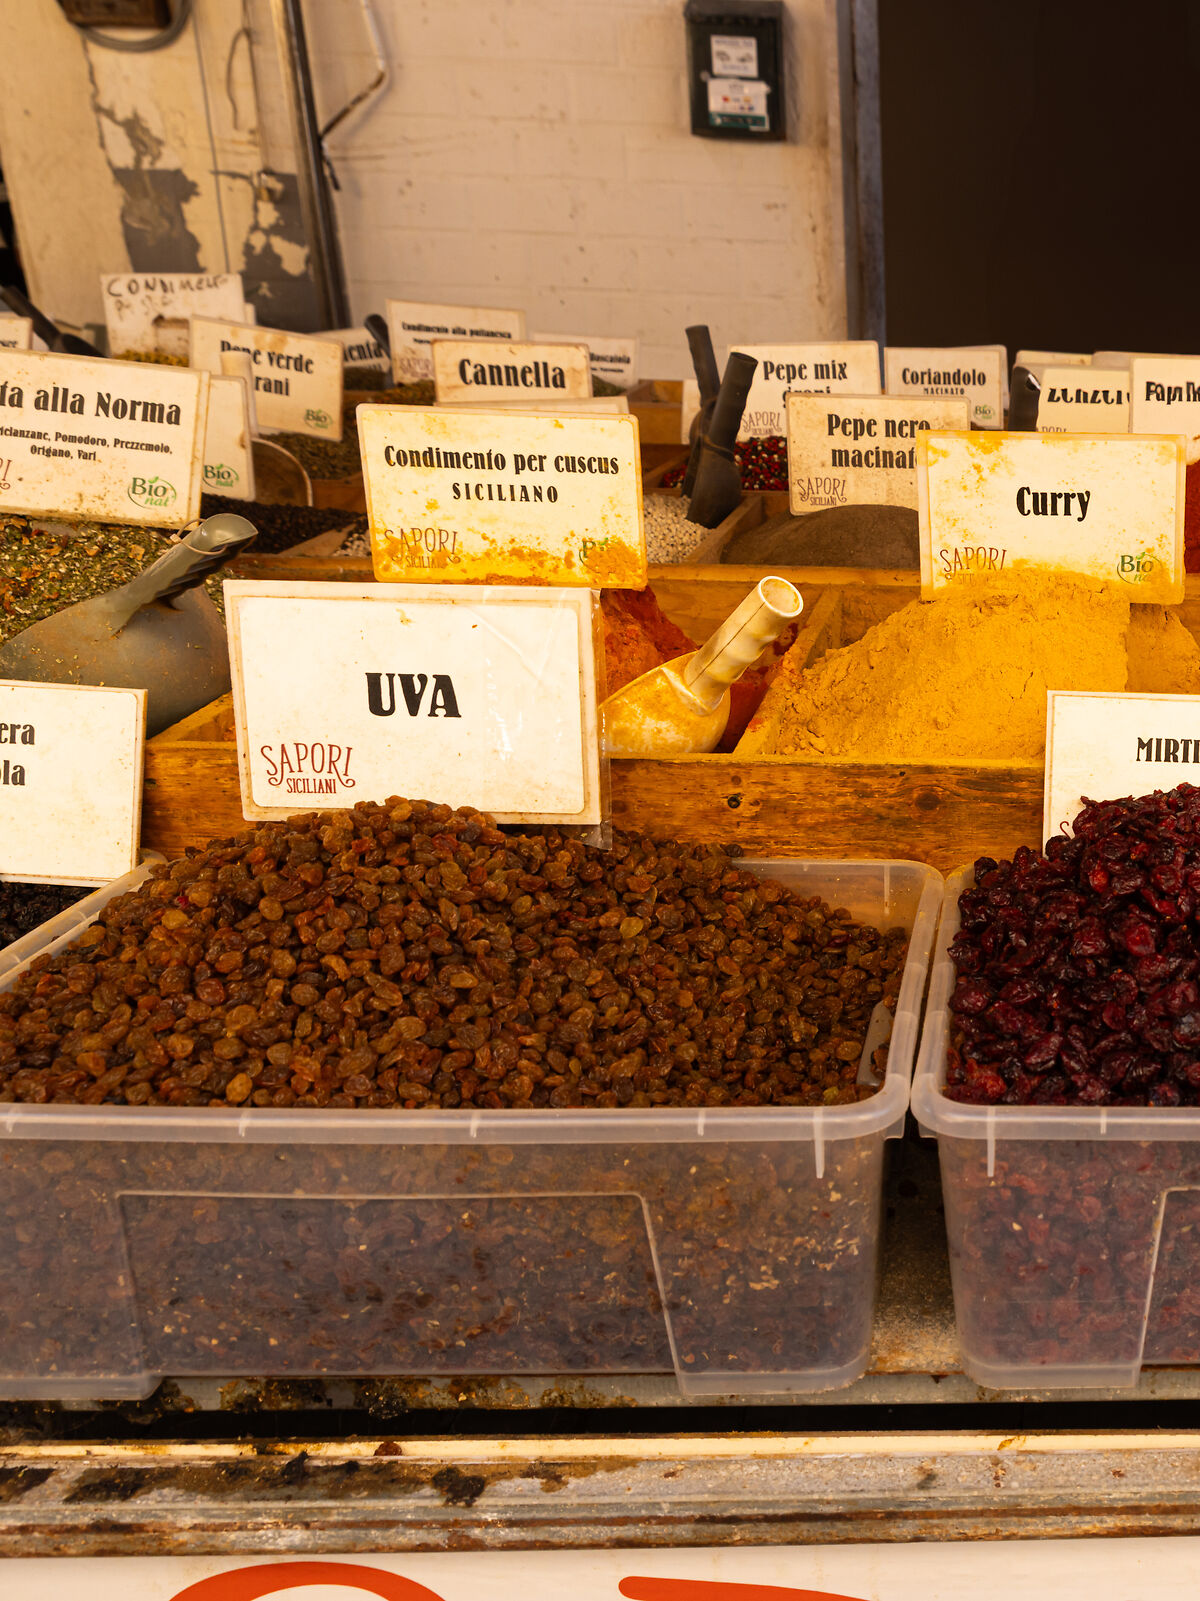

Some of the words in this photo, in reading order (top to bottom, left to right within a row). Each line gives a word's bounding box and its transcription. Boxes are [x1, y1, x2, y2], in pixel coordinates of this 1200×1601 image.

[267, 350, 314, 374] verde
[458, 358, 566, 389] Cannella
[763, 360, 808, 384] Pepe
[814, 359, 848, 381] mix
[255, 375, 290, 397] rani
[902, 367, 987, 387] Coriandolo
[34, 386, 85, 415] alla
[95, 391, 181, 425] Norma
[0, 426, 51, 441] elanzane,
[827, 413, 877, 441] Pepe
[384, 446, 506, 471] Condimento
[514, 454, 547, 475] per
[554, 455, 620, 475] cuscus
[831, 446, 917, 469] macinat
[204, 464, 231, 480] Bio
[132, 476, 168, 497] Bio
[452, 482, 559, 504] SICILIANO
[797, 477, 847, 502] SAPORI
[1016, 486, 1091, 522] Curry
[939, 546, 1008, 577] SAPORI
[1121, 552, 1154, 573] Bio
[365, 673, 462, 718] UVA
[260, 743, 356, 787] SAPORI
[286, 778, 337, 794] SICILIANI
